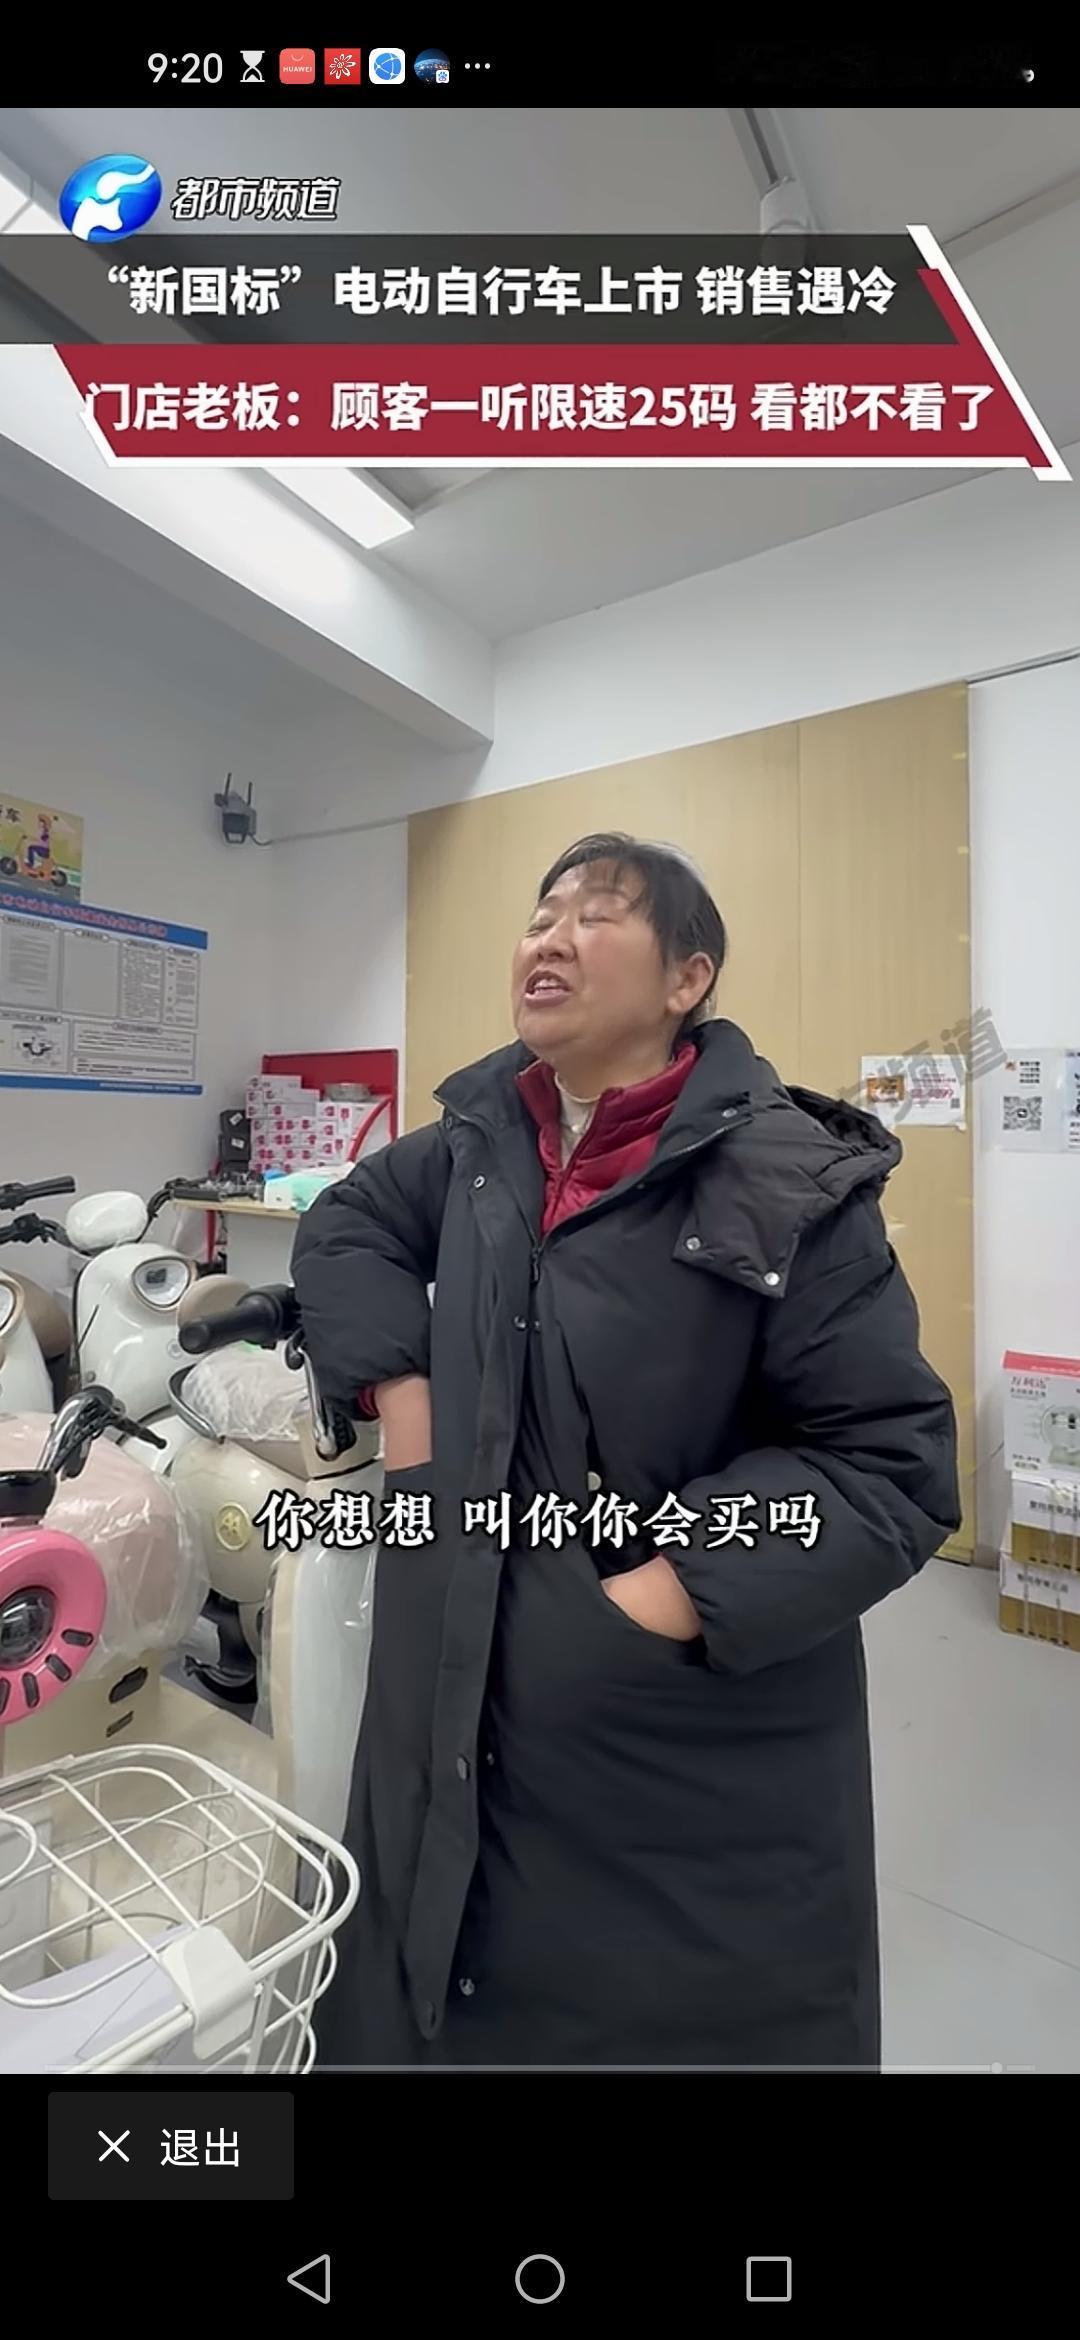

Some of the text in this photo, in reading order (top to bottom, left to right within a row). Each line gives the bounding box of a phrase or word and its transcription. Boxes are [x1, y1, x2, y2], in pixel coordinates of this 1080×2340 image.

[147, 52, 223, 84] 9:20
[282, 65, 313, 73] HUAWEI
[160, 2127, 240, 2168] 退出
